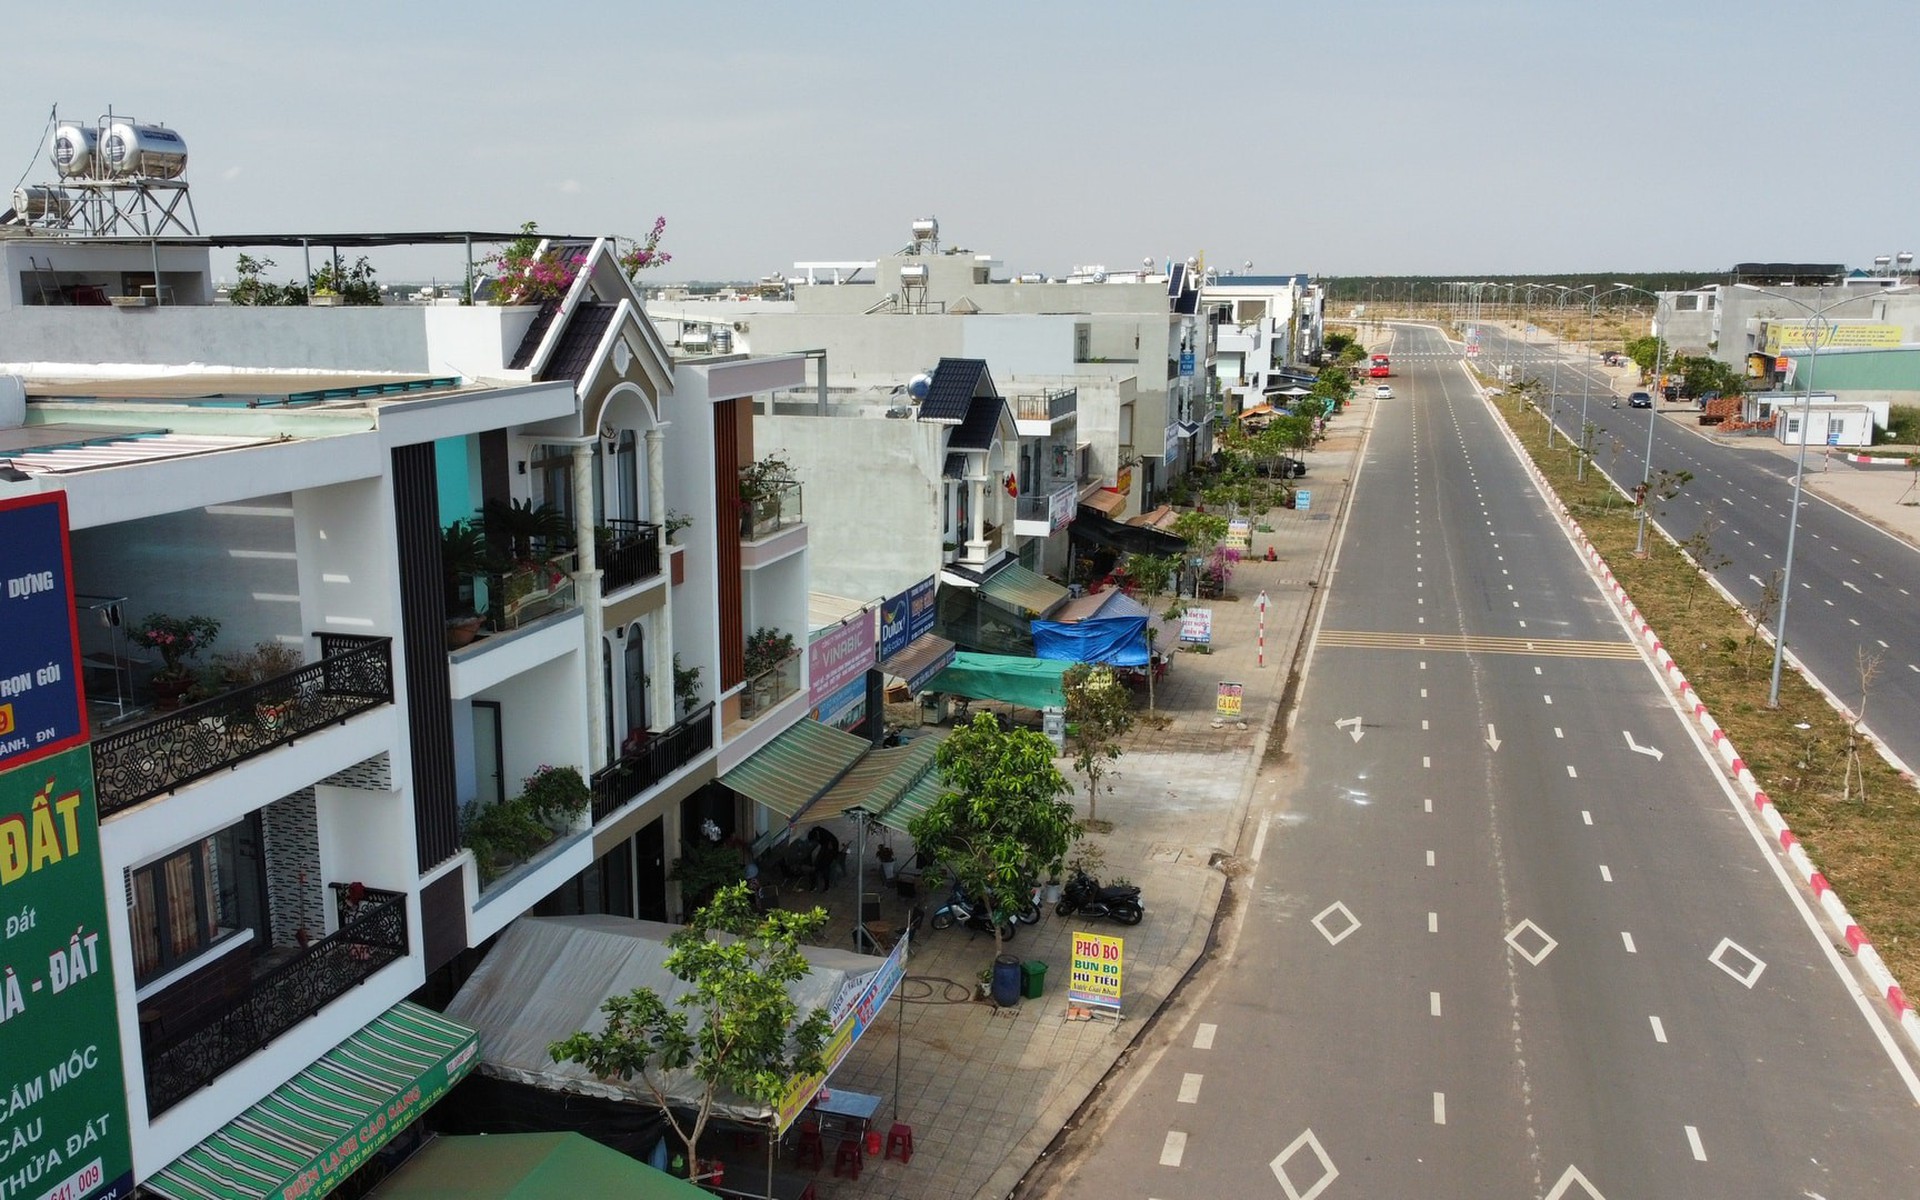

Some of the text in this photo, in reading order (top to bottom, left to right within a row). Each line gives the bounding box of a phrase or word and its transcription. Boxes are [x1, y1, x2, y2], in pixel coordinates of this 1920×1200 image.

[8, 571, 54, 600] DỰNG
[883, 617, 904, 642] Dulux
[36, 661, 61, 686] GÓI
[36, 727, 55, 742] ĐN
[0, 778, 80, 886] ĐẤT
[6, 905, 36, 939] Đất
[49, 924, 98, 995] ĐẤT
[1076, 937, 1119, 961] PHỞ BÒ
[66, 1112, 109, 1159] ĐẤT
[282, 1164, 320, 1200] ĐIỆN
[320, 1134, 359, 1175] LẠNH
[359, 1113, 387, 1143] CAO
